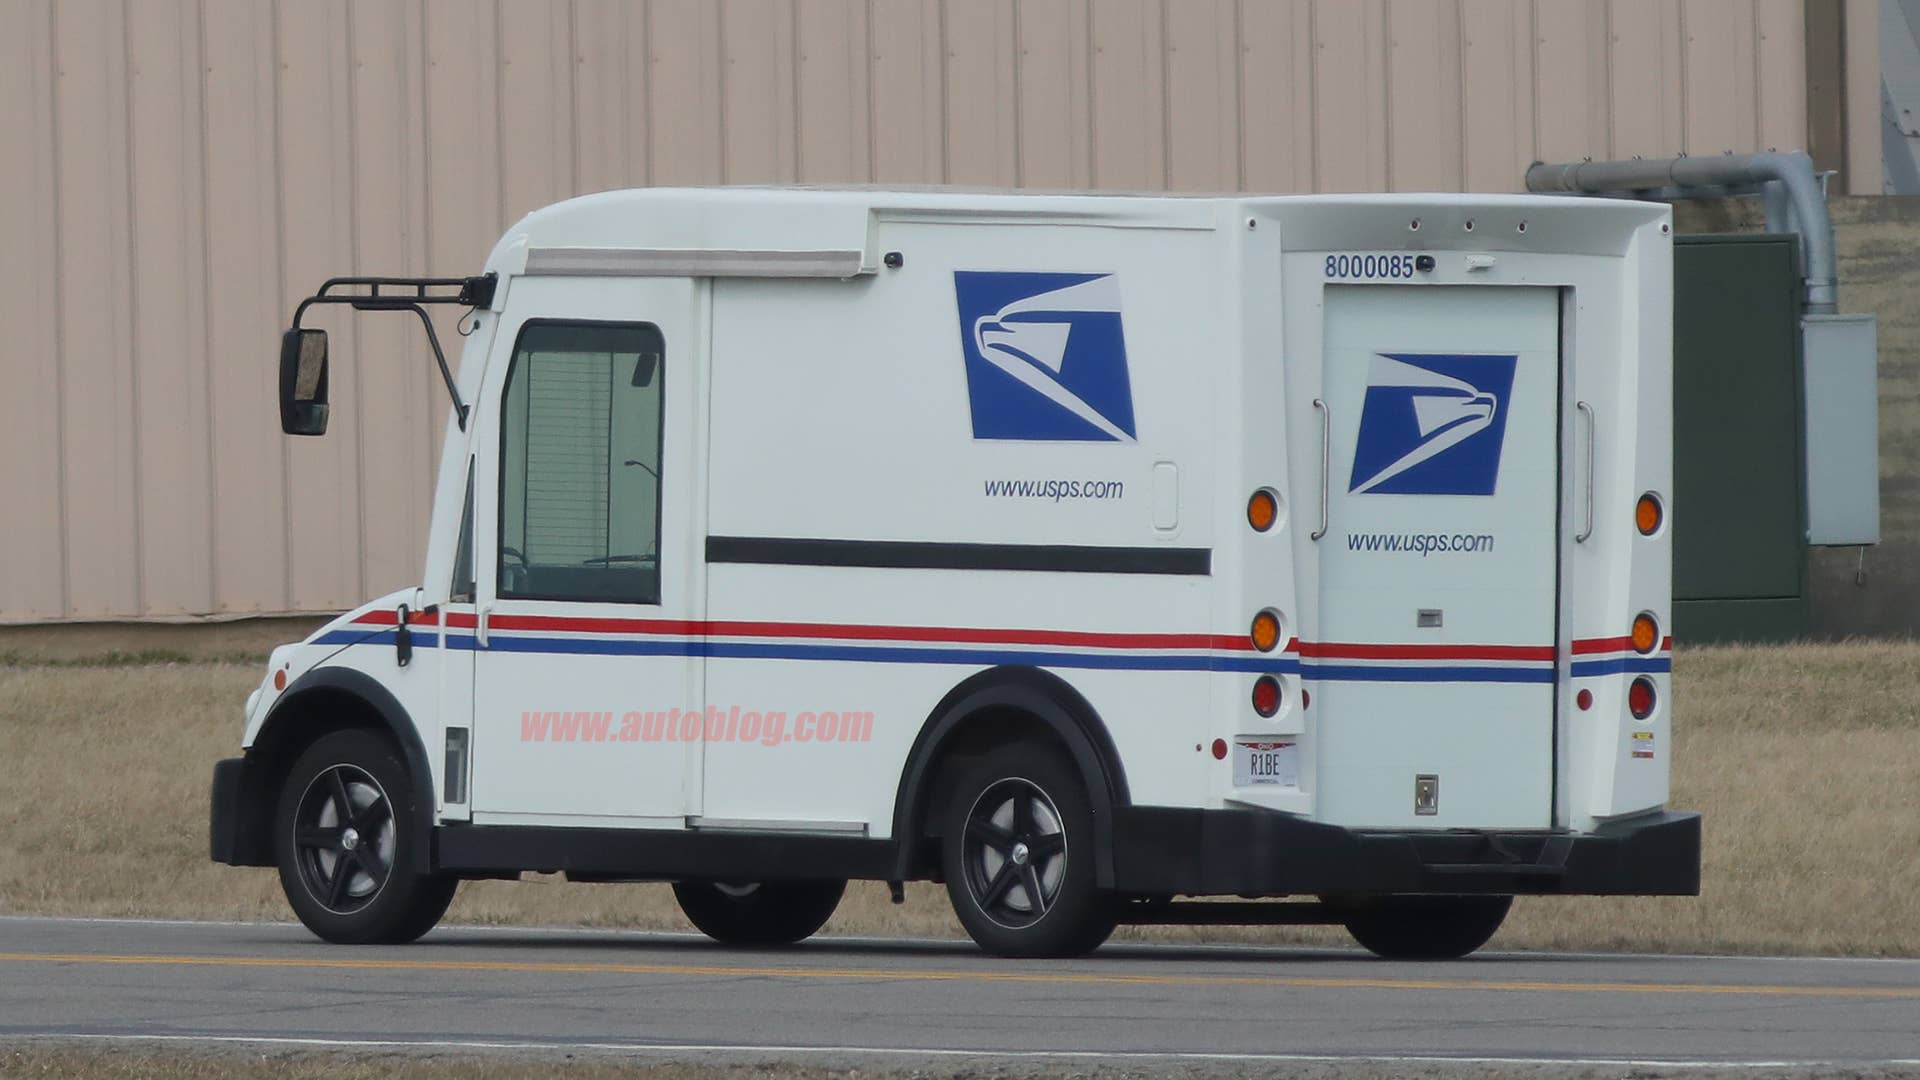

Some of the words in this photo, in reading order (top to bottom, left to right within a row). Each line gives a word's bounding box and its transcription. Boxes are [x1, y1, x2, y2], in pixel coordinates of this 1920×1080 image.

[1326, 255, 1413, 278] 8000085
[985, 480, 1123, 502] www.usps.com
[1348, 534, 1494, 557] www.usps.com
[1251, 753, 1280, 775] R1BE
